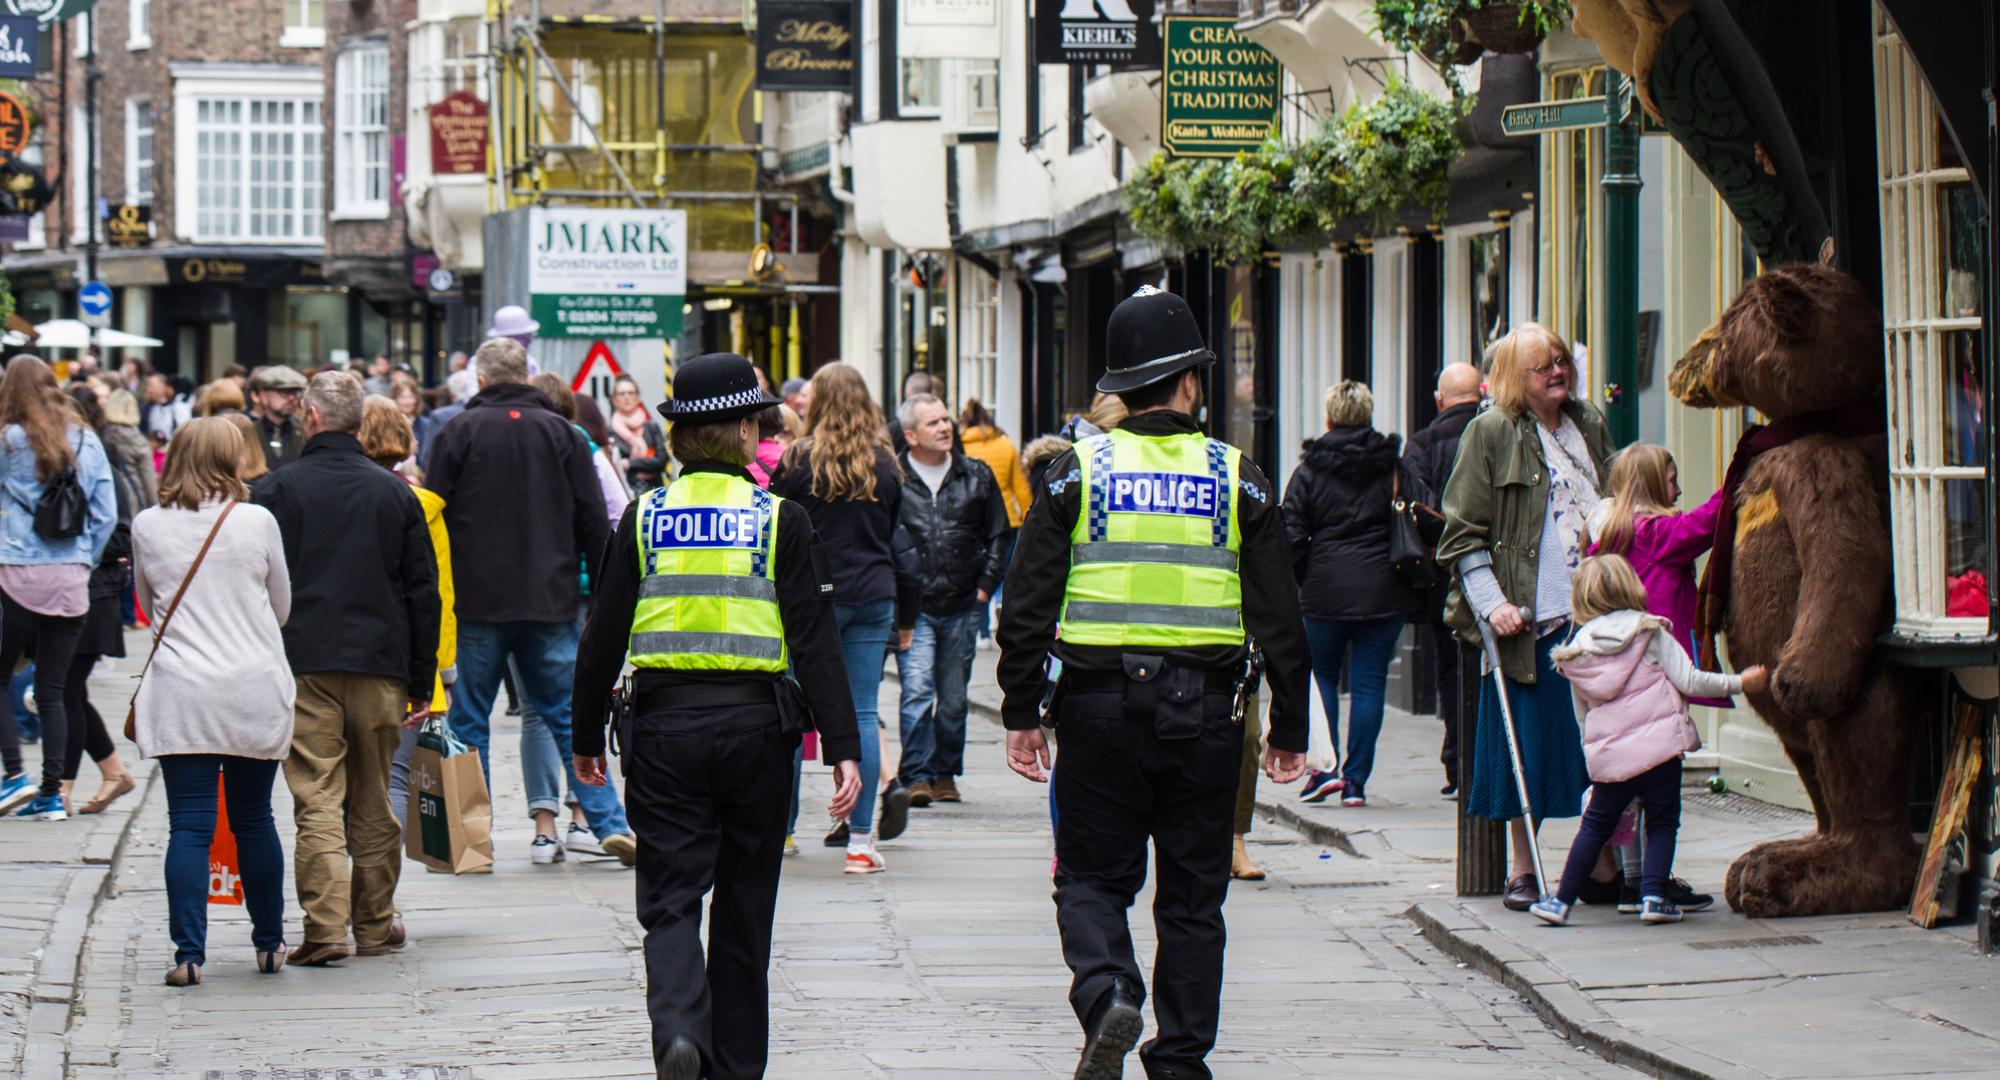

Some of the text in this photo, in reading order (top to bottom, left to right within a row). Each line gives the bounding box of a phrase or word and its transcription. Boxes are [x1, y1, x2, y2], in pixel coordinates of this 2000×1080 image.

[774, 19, 850, 51] Molly
[1062, 28, 1137, 43] KIEHL'S
[1189, 26, 1252, 44] CREA
[764, 47, 855, 71] Brown
[1171, 48, 1275, 65] YOUR OWN
[1169, 70, 1275, 88] CHRISTMAS
[1170, 91, 1274, 109] TRADITION
[1508, 106, 1562, 129] Barley Hall
[537, 222, 672, 254] JMARK
[537, 257, 679, 271] Construction Ltd
[1114, 478, 1214, 511] POLICE
[655, 512, 755, 543] POLICE
[420, 797, 437, 818] an
